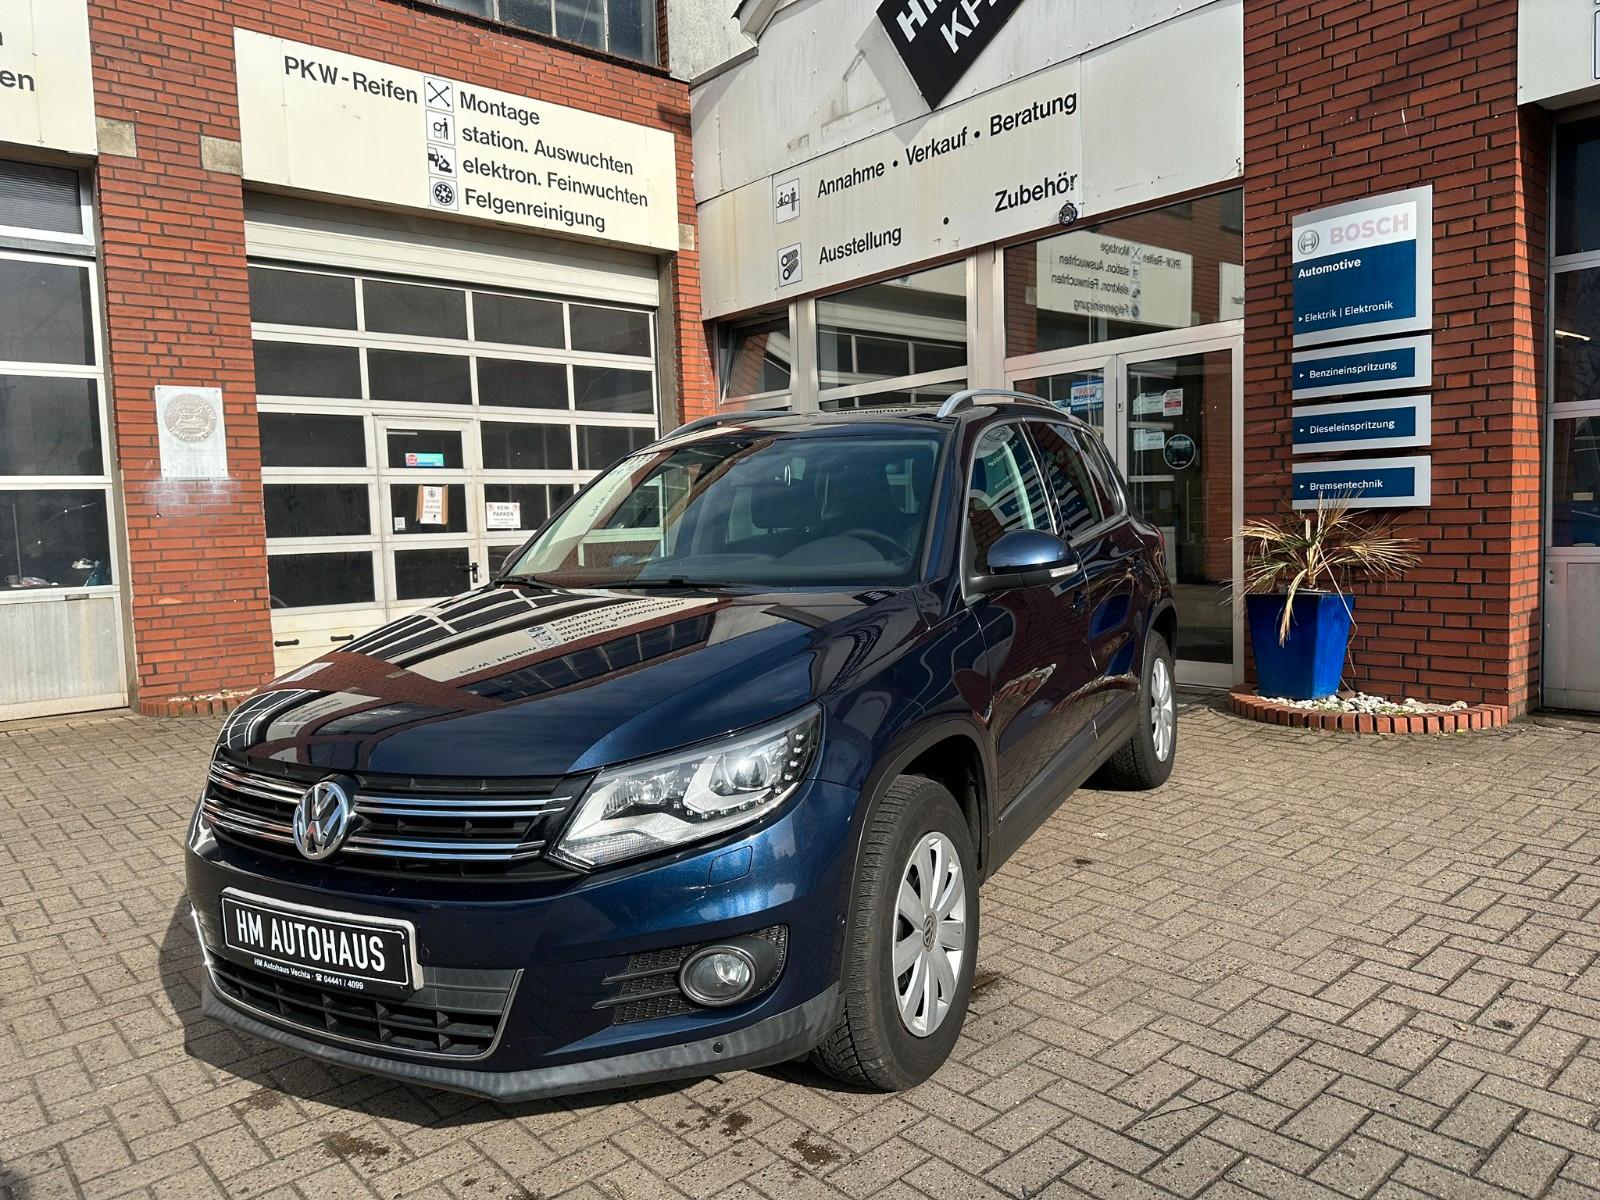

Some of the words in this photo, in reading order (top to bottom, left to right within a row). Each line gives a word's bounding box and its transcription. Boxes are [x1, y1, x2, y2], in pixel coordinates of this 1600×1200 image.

[284, 55, 418, 104] PKW-Reifen
[460, 91, 540, 126] Montage
[462, 125, 530, 154] station.
[534, 139, 634, 175] Auswuchten
[818, 161, 884, 198] Annahme
[905, 127, 967, 166] Verkauf
[990, 92, 1077, 137] Beratung
[463, 157, 542, 187] elektron.
[547, 173, 648, 207] Feinwuchten
[994, 172, 1077, 213] Zubehör
[464, 188, 606, 232] Felgenreinigung
[819, 227, 902, 265] Ausstellung
[1329, 212, 1410, 245] BOSCH
[1298, 257, 1361, 279] Automotive
[1304, 308, 1337, 323] Elektrik
[1344, 299, 1394, 317] Elektronik
[1309, 360, 1398, 380] Benzineinspritzung
[1309, 419, 1396, 436] Dieseleinspritzung
[1309, 479, 1384, 492] Bremsentechnik
[236, 908, 264, 947] HM
[271, 918, 386, 972] AUTOHAUS
[253, 957, 263, 967] HM
[263, 960, 290, 974] Autohaus
[291, 967, 311, 980] Vechta
[323, 976, 342, 986] 04441
[347, 979, 364, 990] 4099
